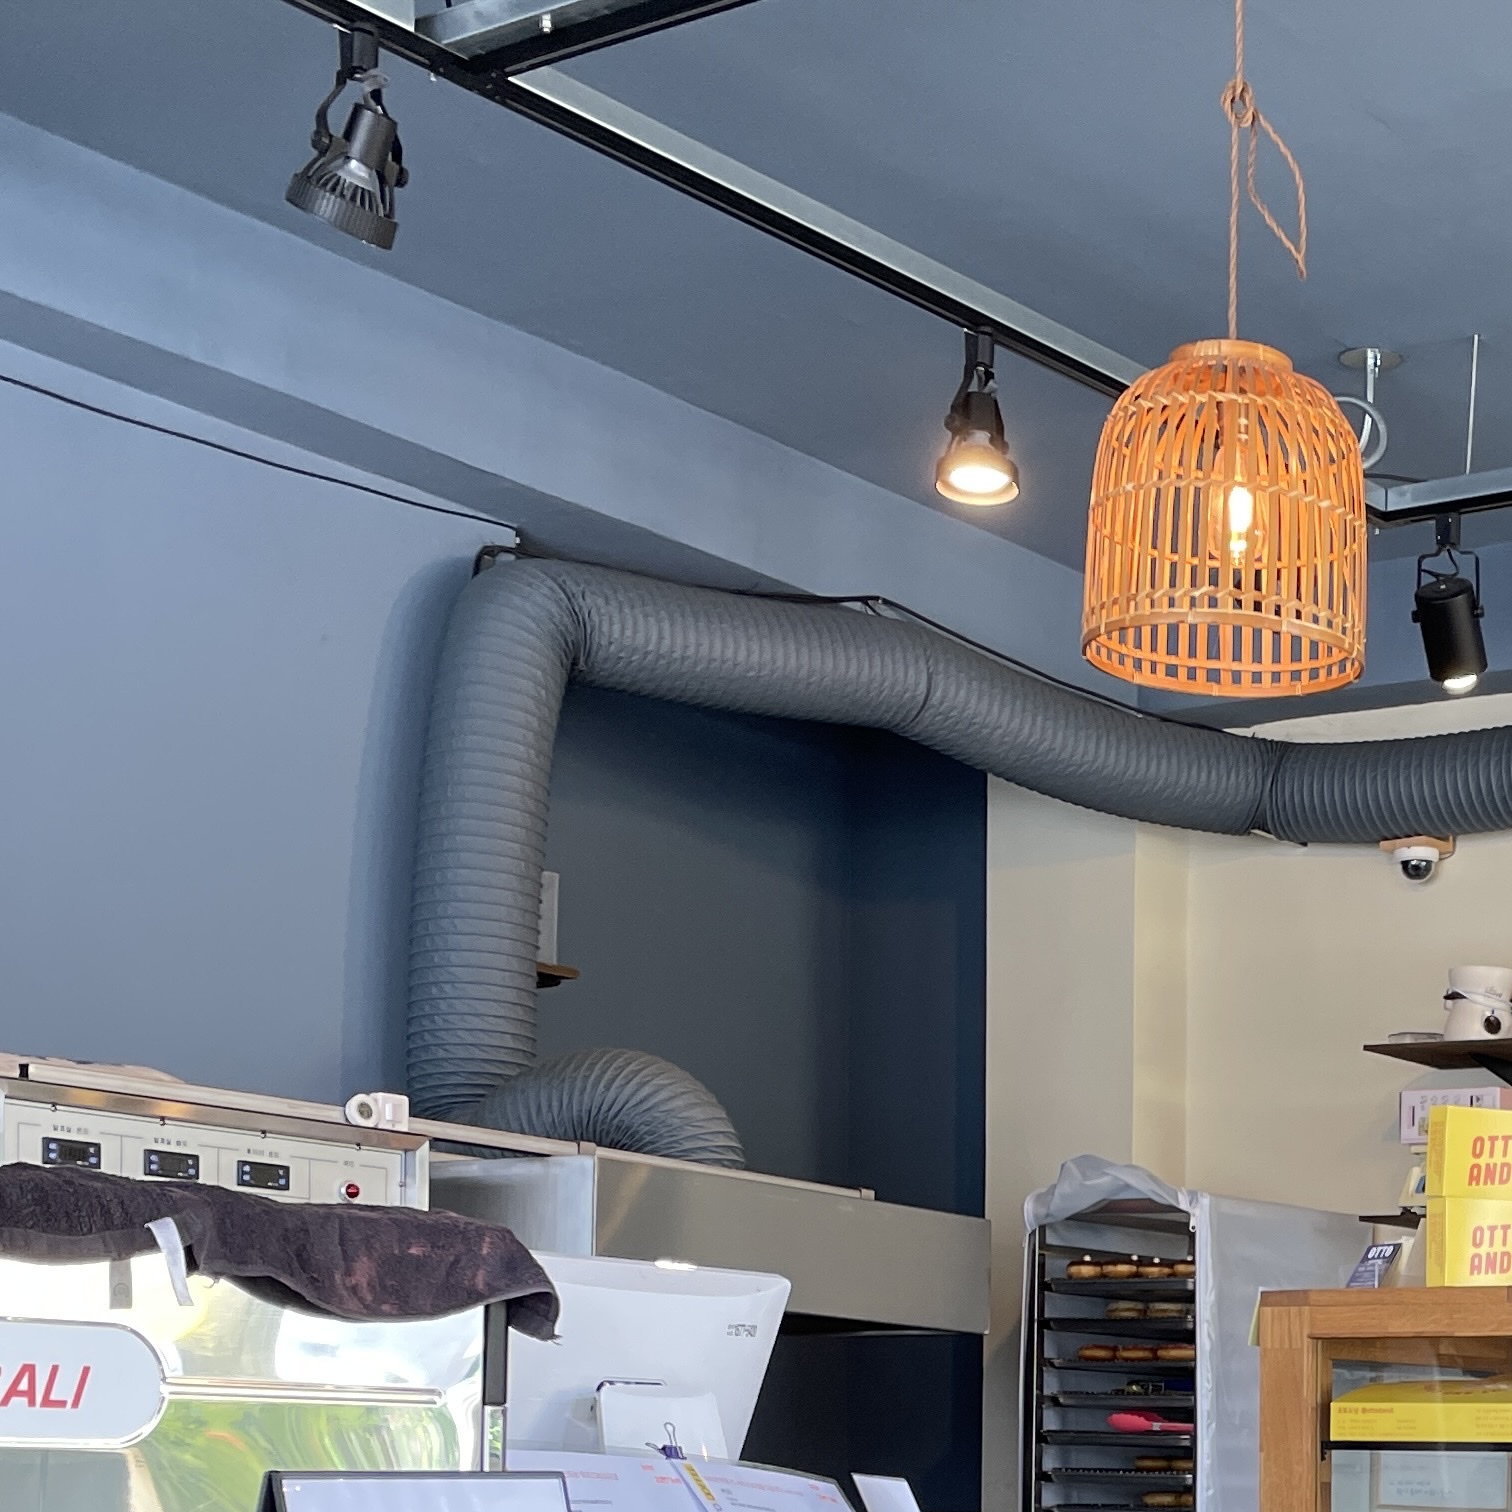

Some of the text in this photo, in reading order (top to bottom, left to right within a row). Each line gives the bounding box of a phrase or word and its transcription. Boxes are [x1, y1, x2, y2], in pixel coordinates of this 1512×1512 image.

[1467, 1162, 1512, 1187] AND
[1367, 1245, 1394, 1259] OTTO
[1469, 1250, 1512, 1276] AND
[0, 1363, 91, 1409] ALI
